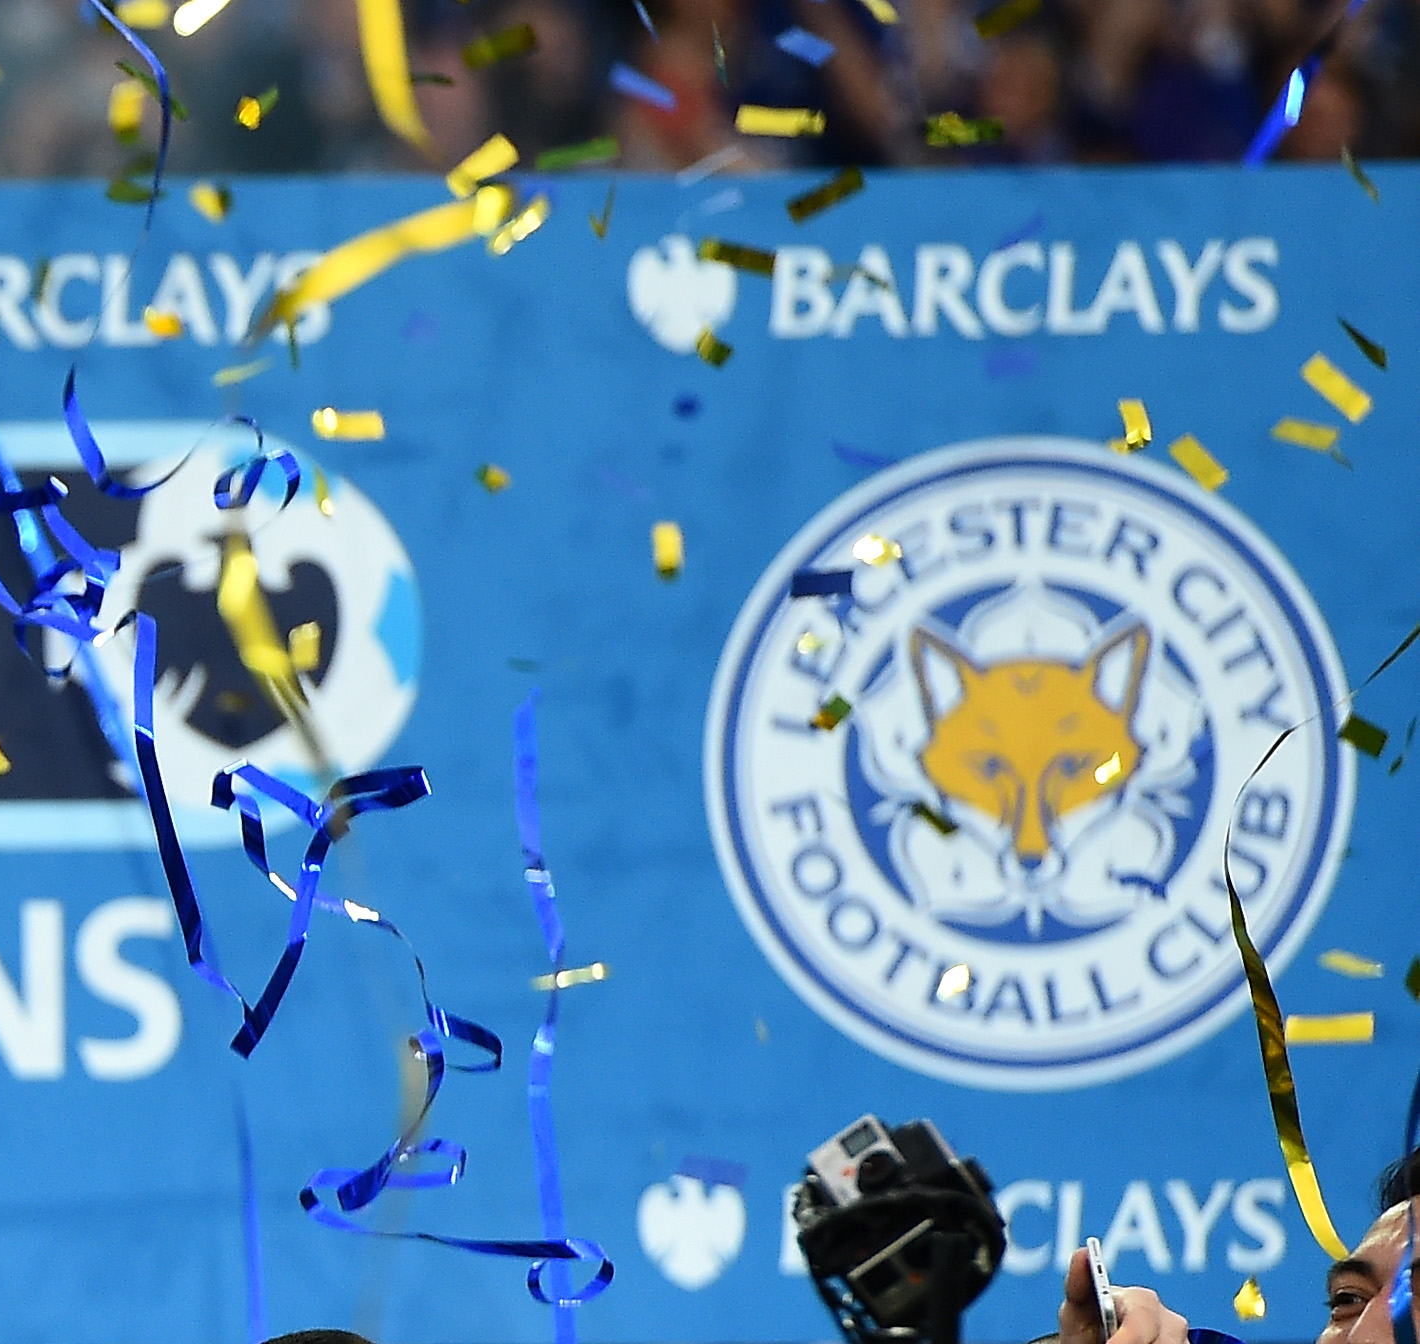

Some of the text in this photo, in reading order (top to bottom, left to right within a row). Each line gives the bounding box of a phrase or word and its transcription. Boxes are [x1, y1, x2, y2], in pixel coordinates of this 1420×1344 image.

[768, 238, 1281, 341] BARCLAYS
[1170, 564, 1299, 740] CITY
[771, 786, 1294, 1029] FOOTBALL CLUB
